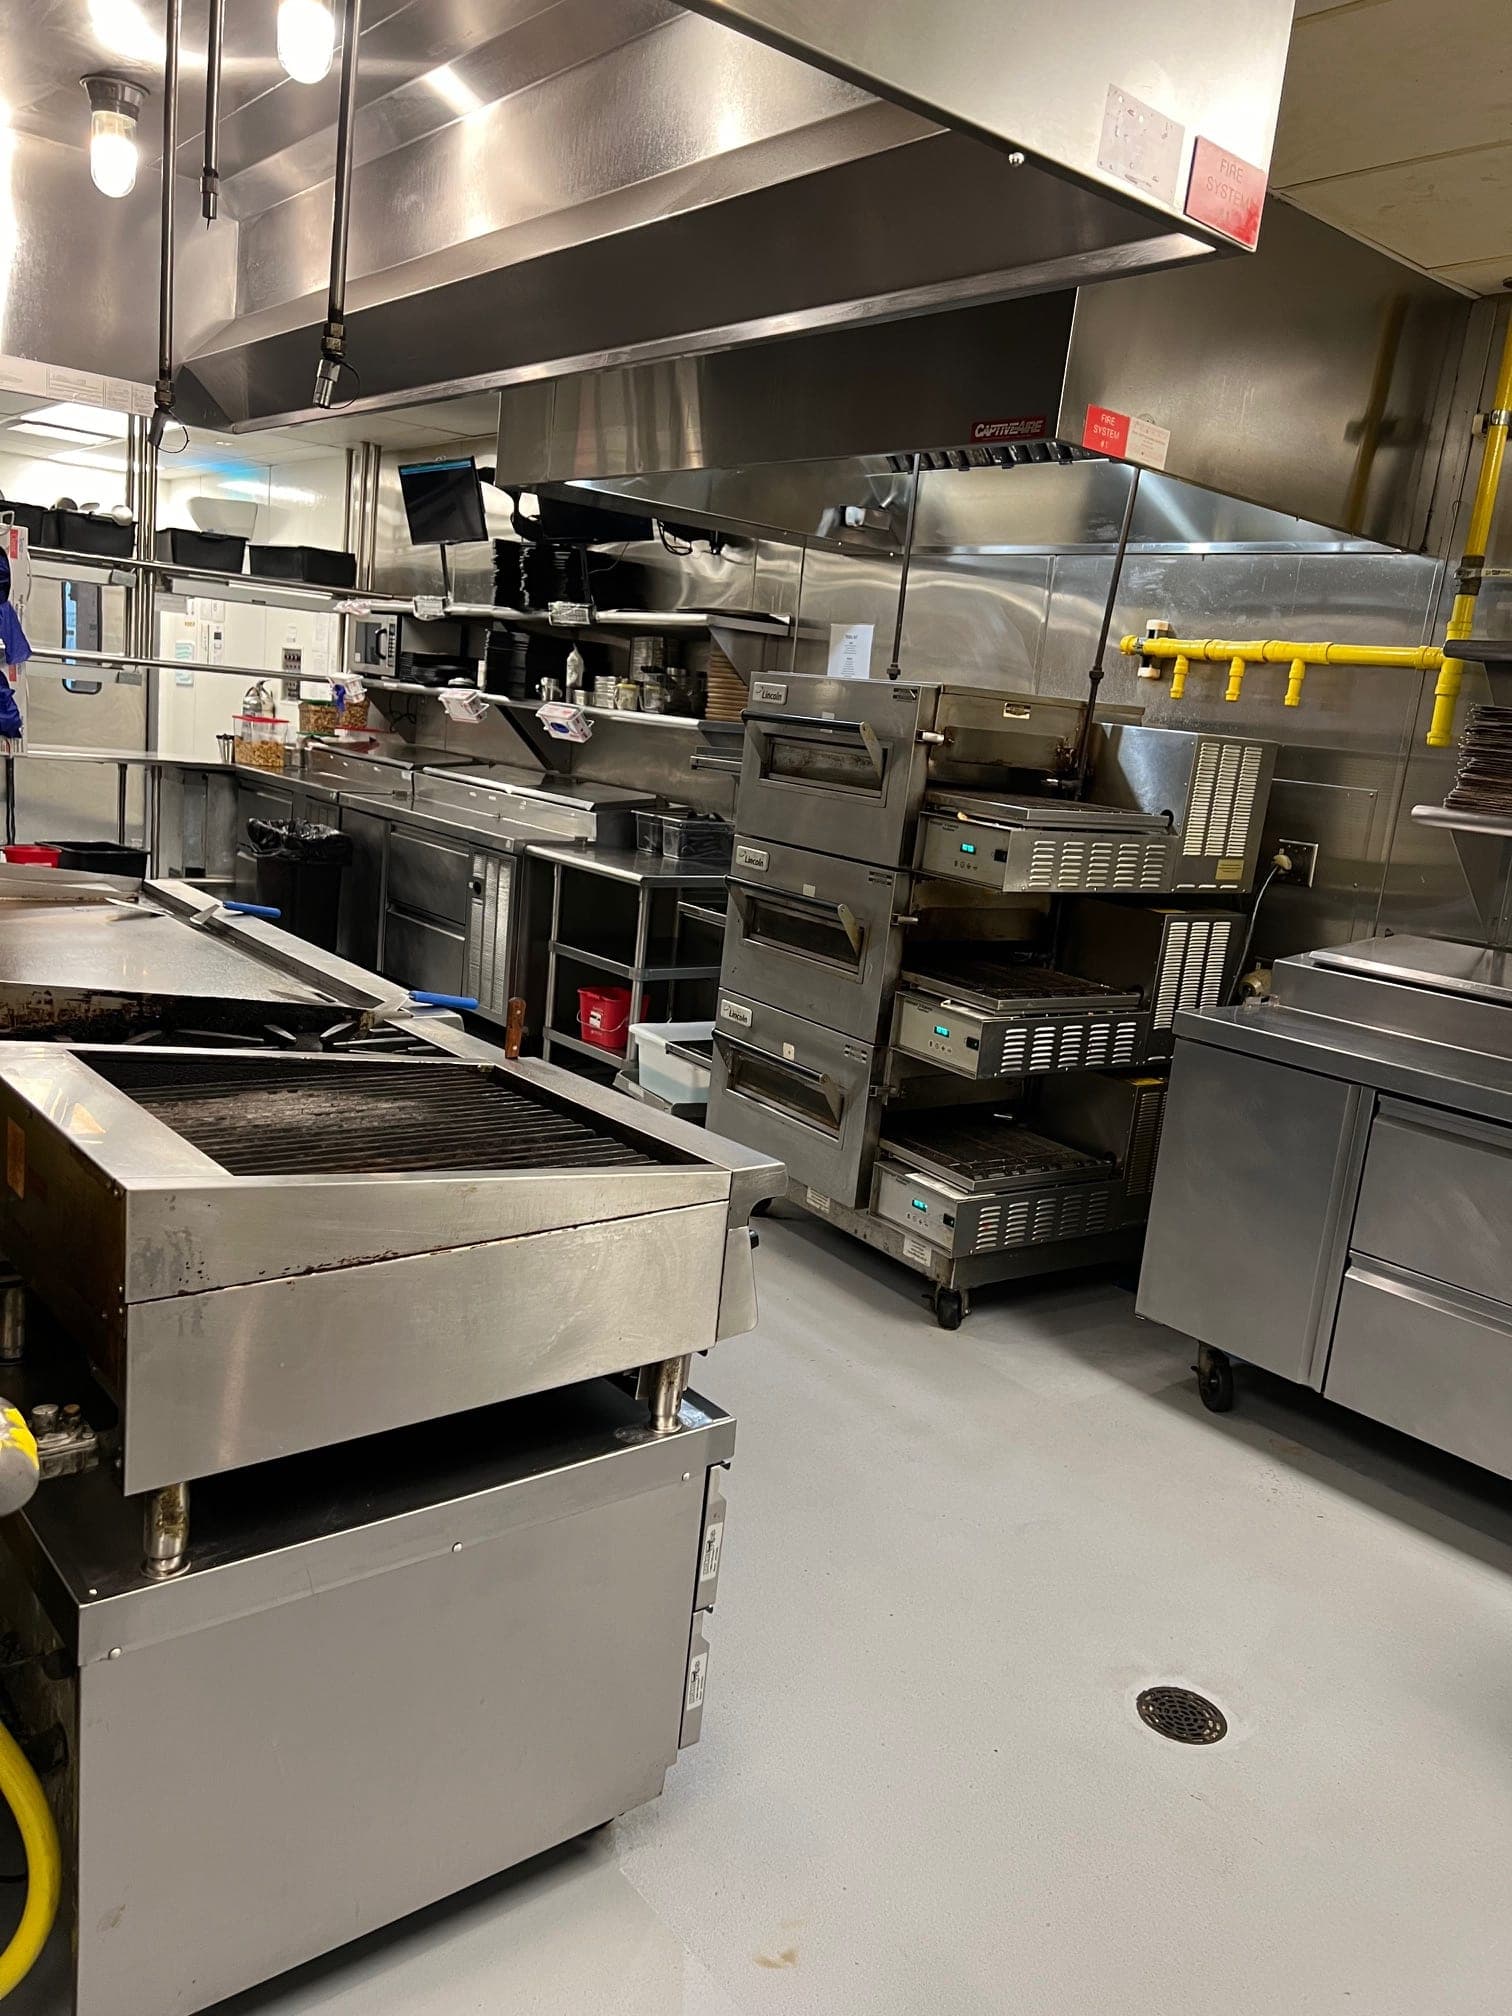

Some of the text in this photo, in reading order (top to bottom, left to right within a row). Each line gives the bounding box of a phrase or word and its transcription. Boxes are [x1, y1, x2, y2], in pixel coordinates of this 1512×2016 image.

[1220, 158, 1243, 184] FIRE
[1206, 175, 1251, 210] SYSTEM
[1101, 413, 1116, 427] FIRE
[1092, 424, 1120, 440] SYSTEM
[761, 689, 782, 701] Lincoln
[744, 854, 764, 867] Lincoln
[728, 1009, 748, 1023] Lincoln
